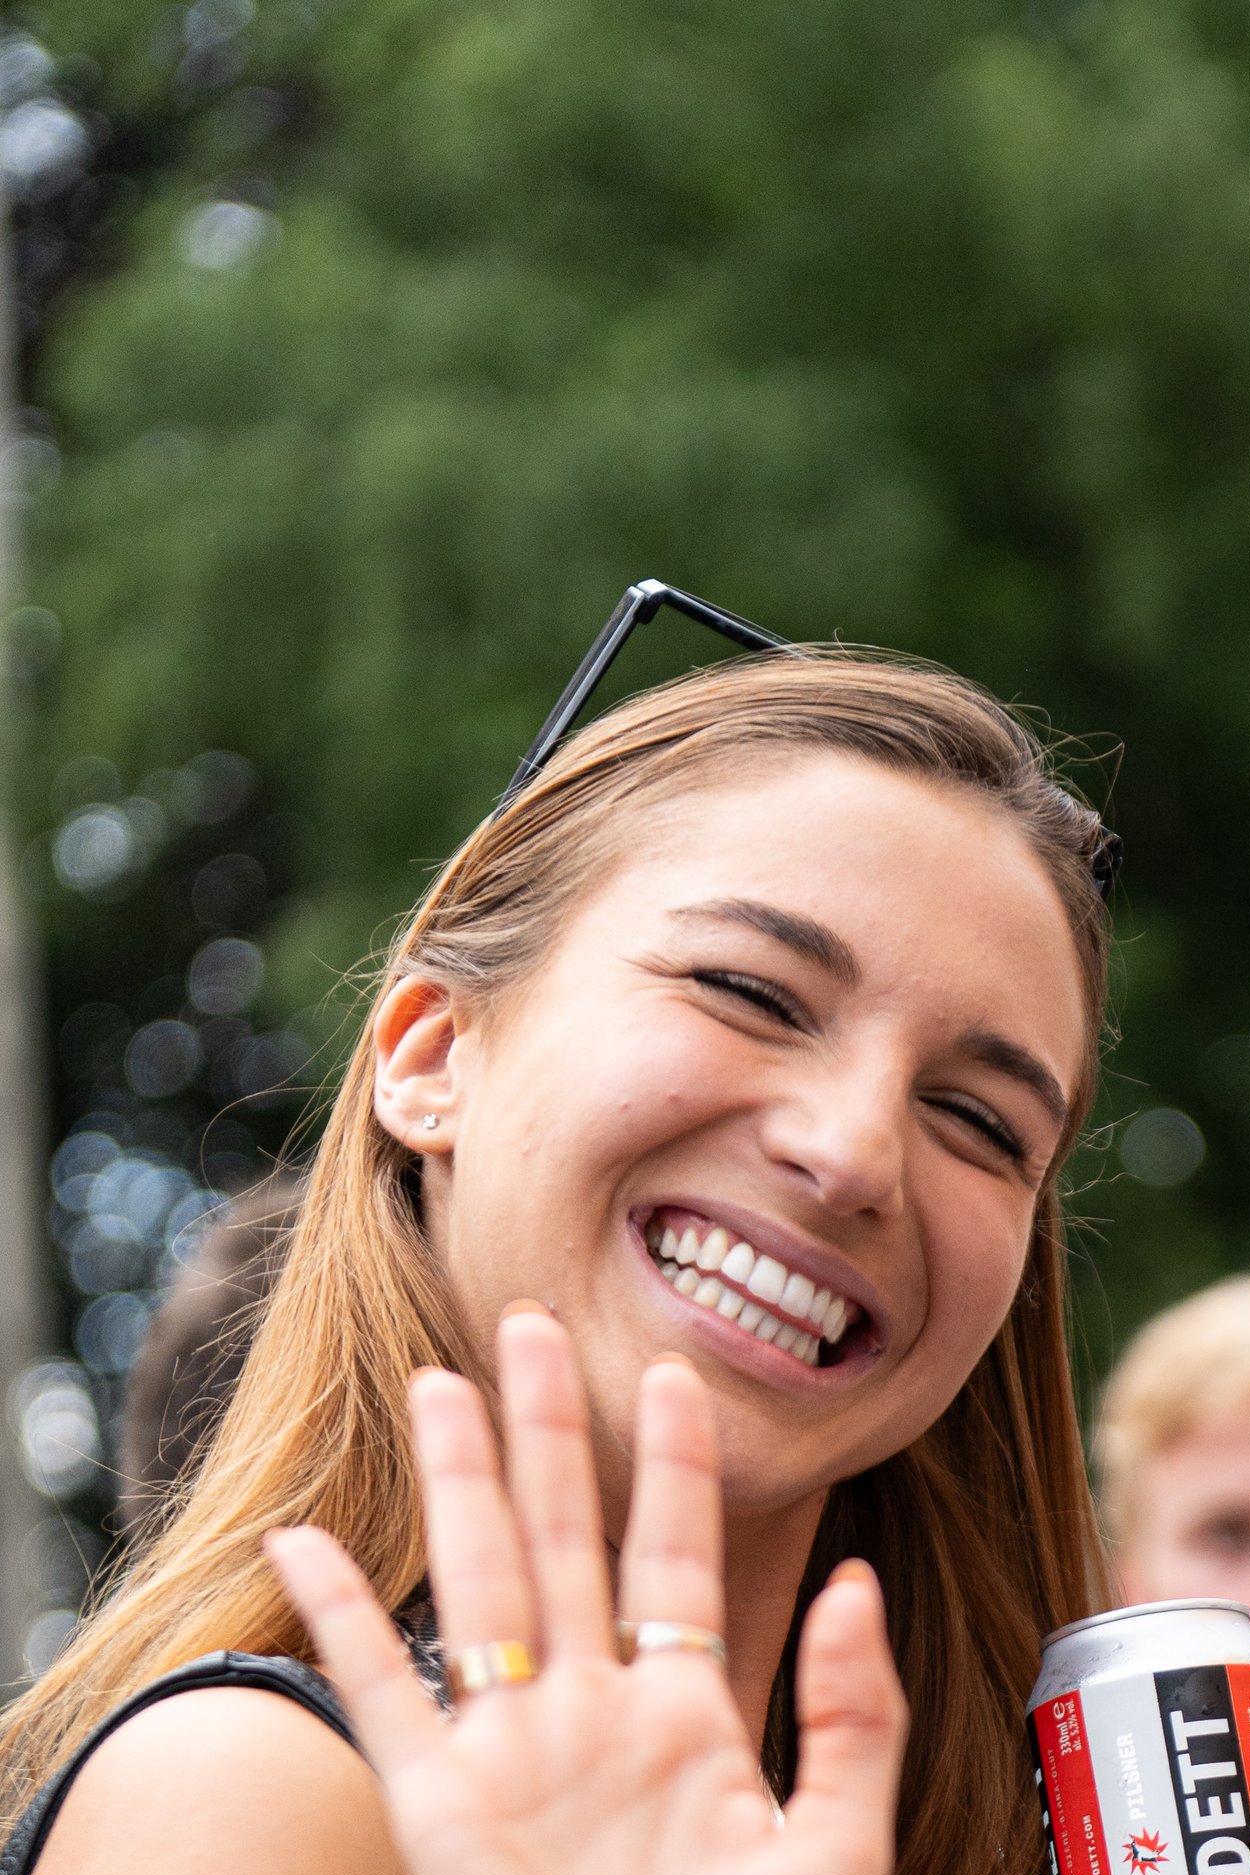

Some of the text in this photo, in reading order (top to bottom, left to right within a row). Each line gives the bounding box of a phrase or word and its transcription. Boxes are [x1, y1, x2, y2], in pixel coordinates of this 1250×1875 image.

[1065, 1698, 1076, 1714] vol.
[1056, 1721, 1073, 1756] 330ml
[1072, 1736, 1082, 1751] alc.
[1116, 1731, 1147, 1822] PILSNER
